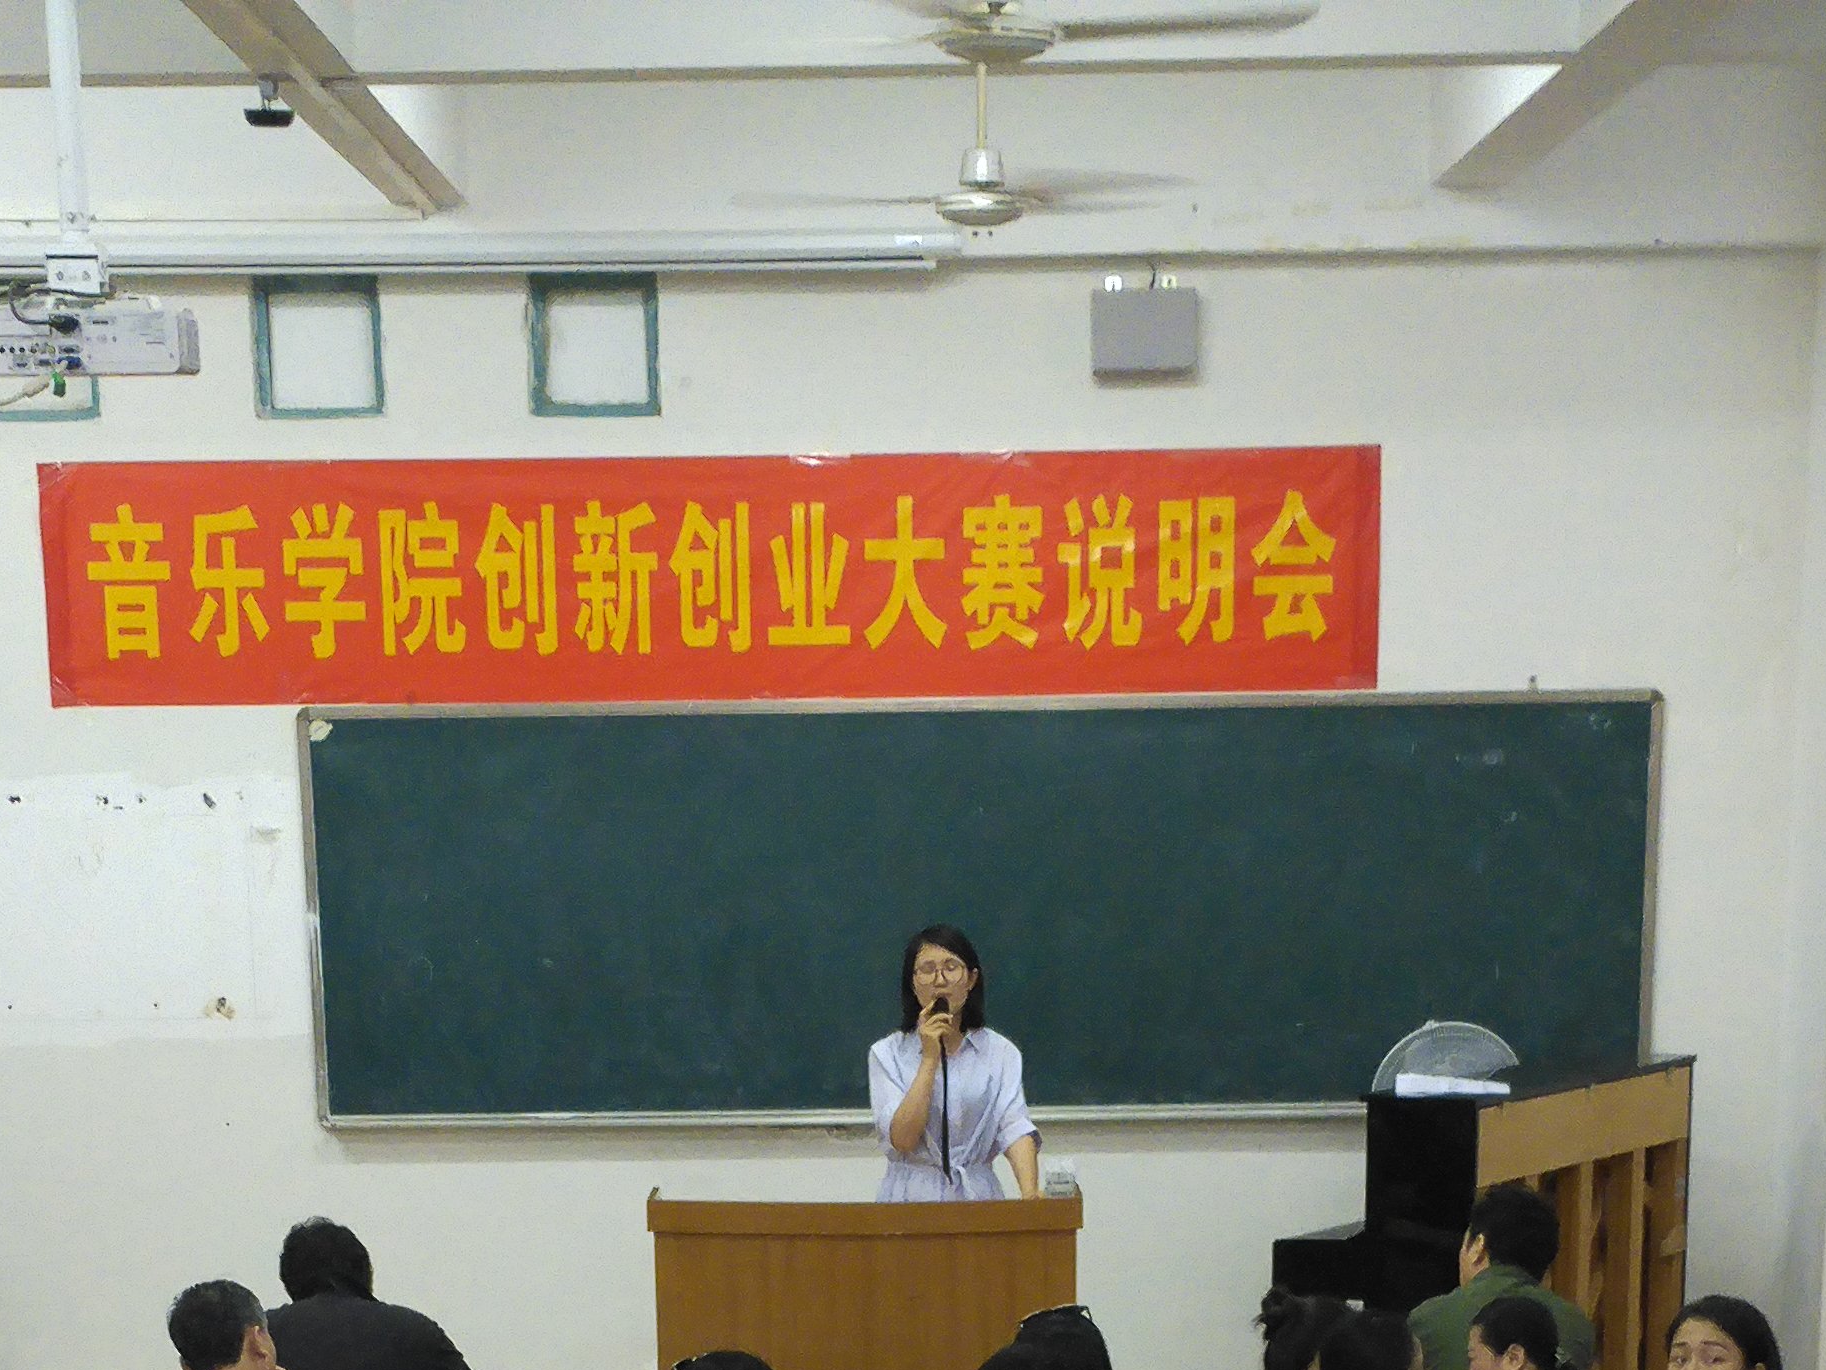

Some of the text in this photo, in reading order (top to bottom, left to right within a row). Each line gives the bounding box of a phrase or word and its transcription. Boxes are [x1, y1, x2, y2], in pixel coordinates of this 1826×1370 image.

[87, 490, 1338, 658] 音乐学院创新创业大赛说明会
